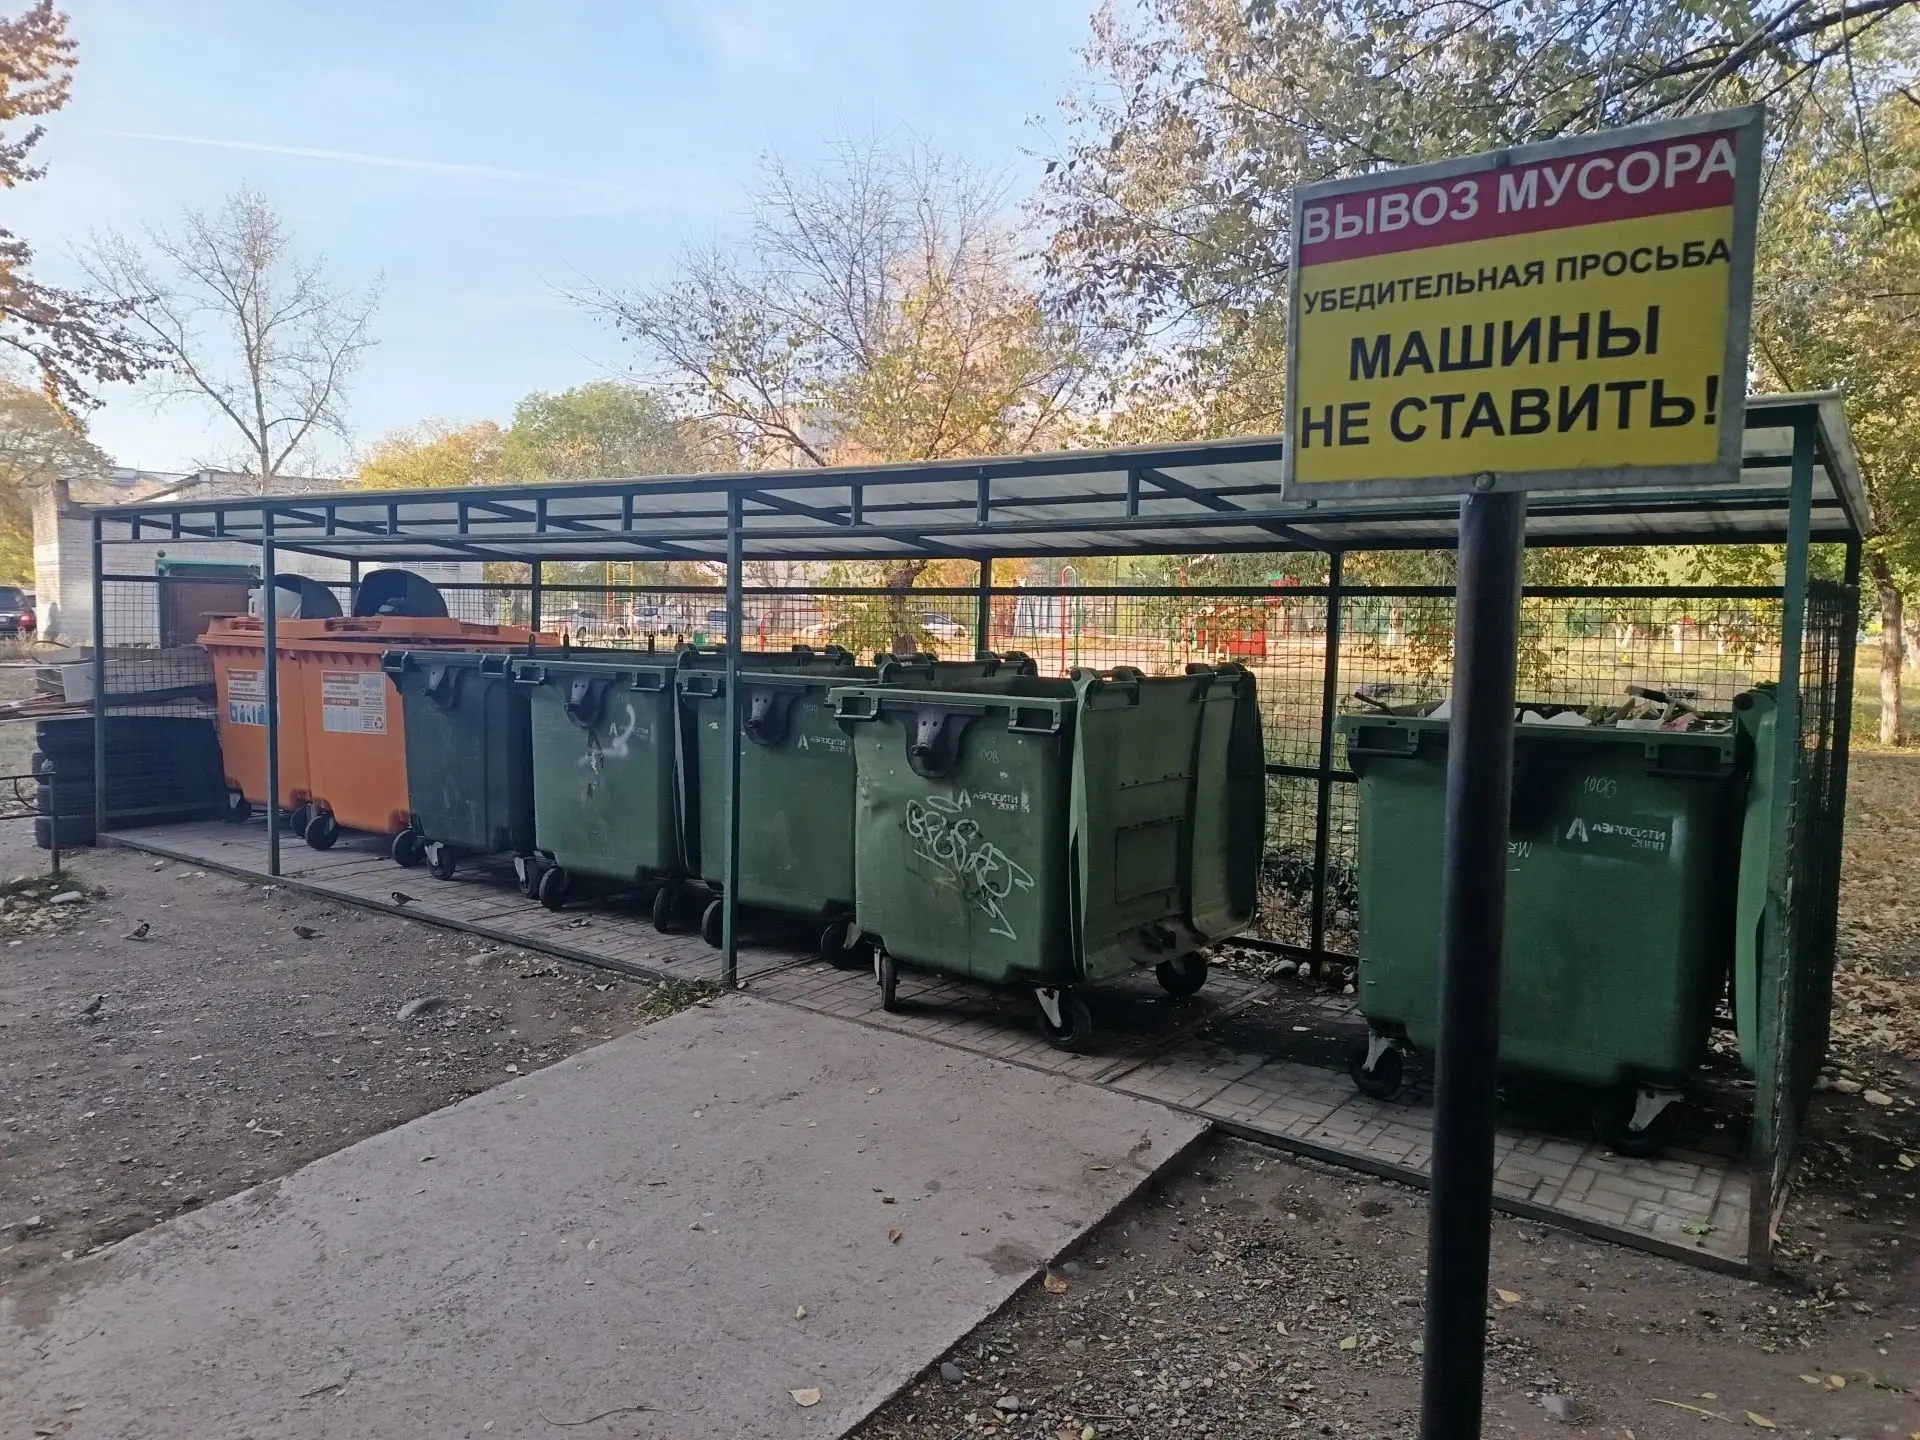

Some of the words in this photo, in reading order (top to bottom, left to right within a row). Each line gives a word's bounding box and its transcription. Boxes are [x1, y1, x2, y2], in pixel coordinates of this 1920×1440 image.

[1302, 181, 1479, 245] ВЫВОЗ
[1497, 138, 1736, 213] МУСОРА
[1304, 261, 1544, 314] УБЕДИТЕЛЬНАЯ
[1556, 239, 1731, 281] ПРОСЬБА
[1349, 305, 1660, 381] МАШИНЫ
[1301, 402, 1370, 448] НЕ
[1390, 375, 1719, 443] СТАВИТЬ!
